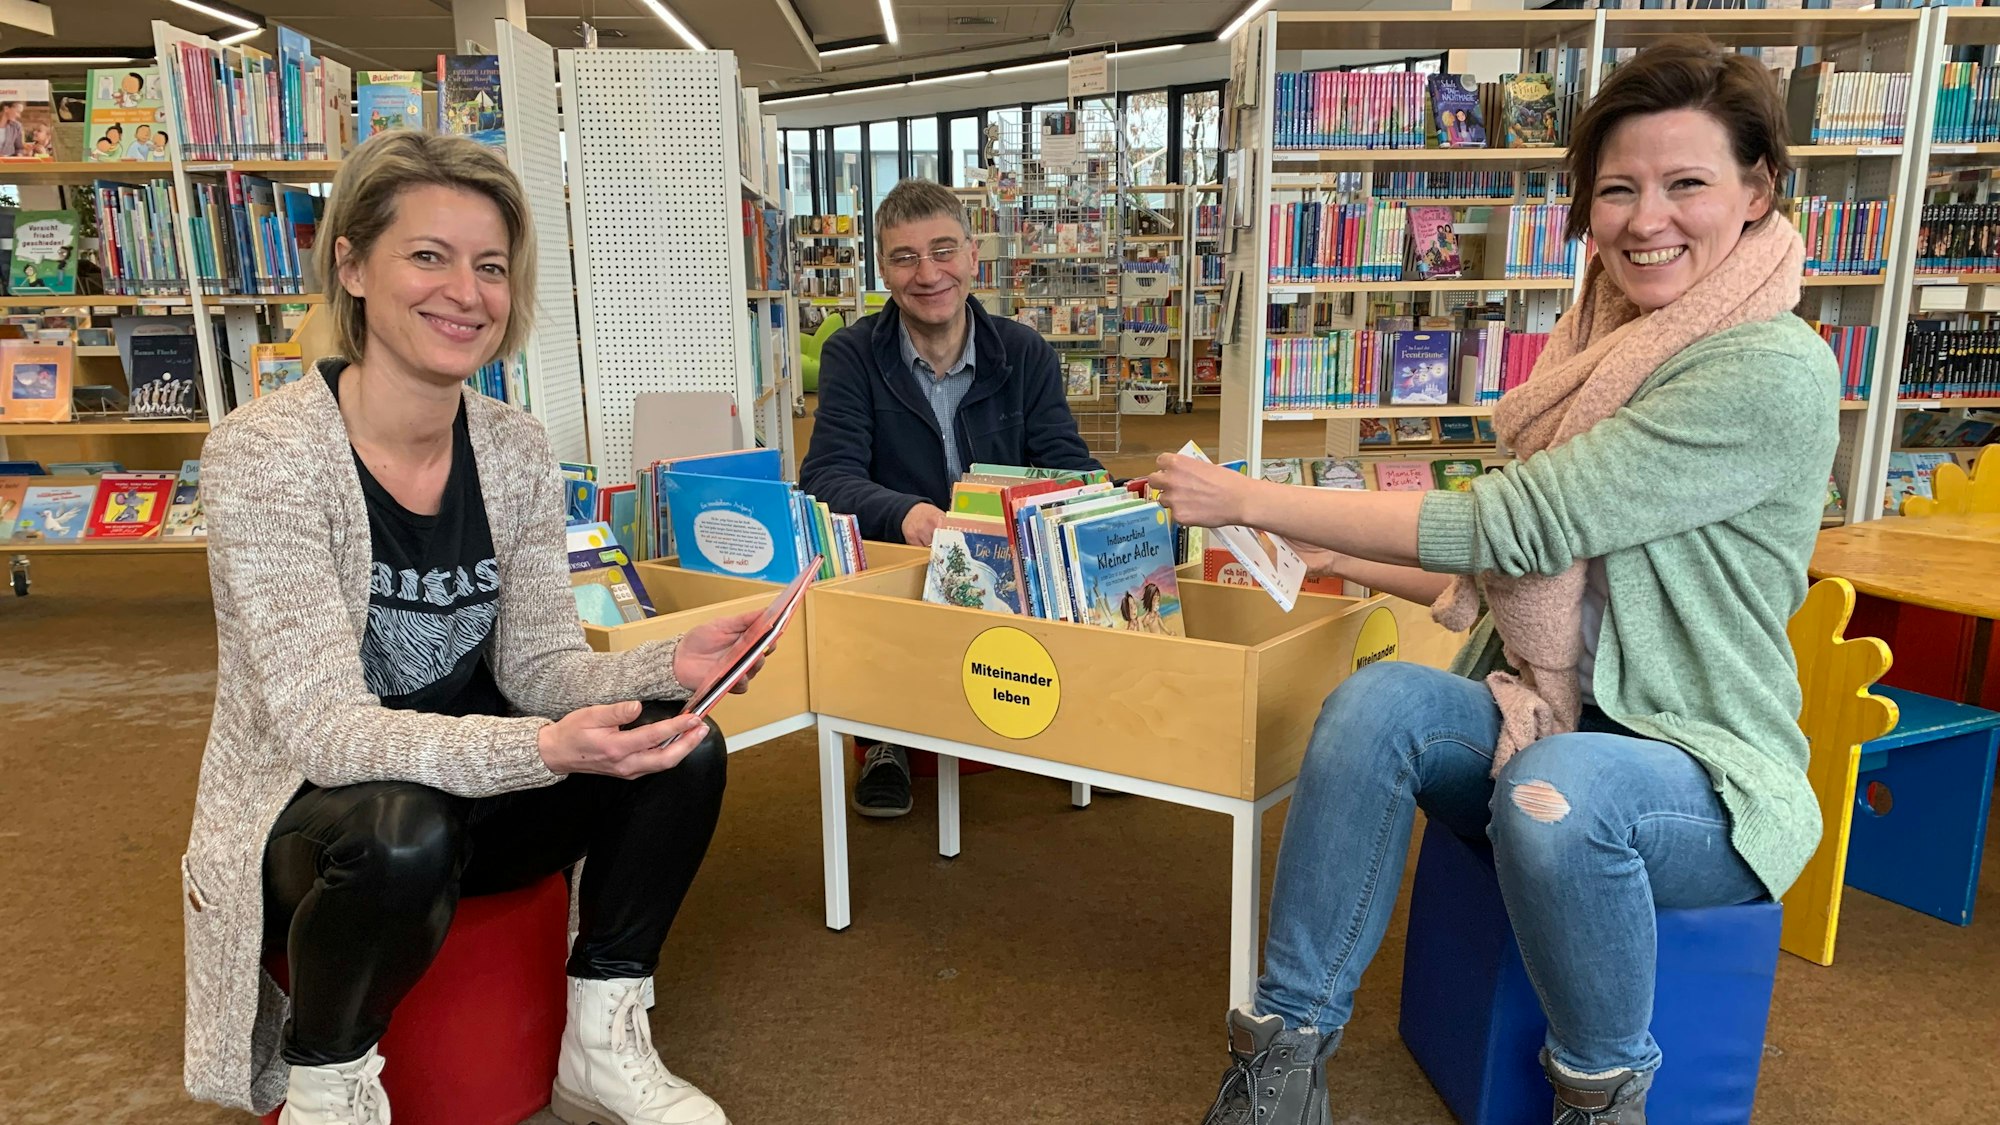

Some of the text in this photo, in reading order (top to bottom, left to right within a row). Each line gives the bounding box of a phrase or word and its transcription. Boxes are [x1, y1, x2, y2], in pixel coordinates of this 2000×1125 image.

[22, 240, 64, 248] geschieden!
[1107, 527, 1145, 546] Indianerkind
[975, 543, 991, 559] Die
[1097, 552, 1132, 570] Kleiner
[1134, 541, 1159, 560] Adler
[1356, 643, 1396, 671] Miteinander
[971, 662, 1053, 688] Miteinander
[993, 688, 1030, 706] leben
